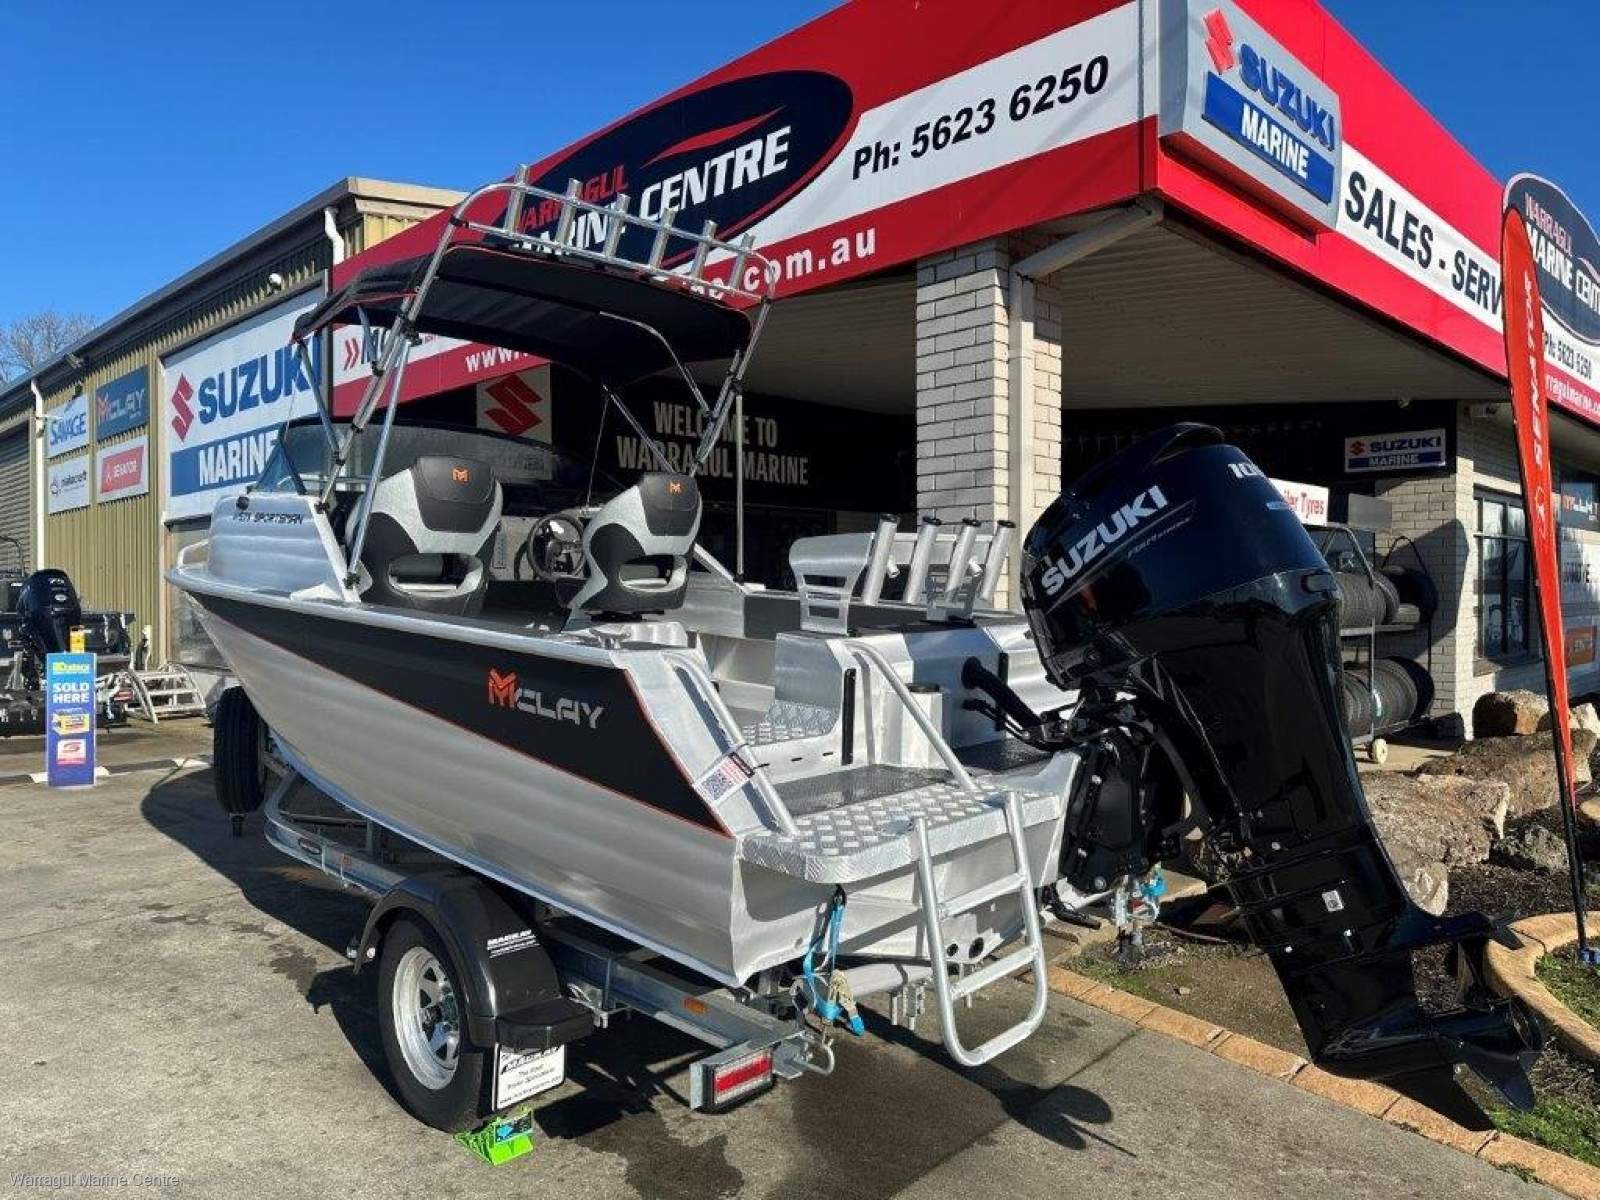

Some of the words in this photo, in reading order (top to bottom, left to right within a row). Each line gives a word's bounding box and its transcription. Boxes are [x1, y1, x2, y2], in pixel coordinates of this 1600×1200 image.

[852, 141, 901, 180] Ph:
[910, 98, 996, 158] 5623
[1008, 55, 1109, 121] 6250
[1239, 43, 1334, 152] SUZUKI
[1241, 103, 1309, 179] MARINE
[640, 126, 791, 222] CENTRE
[1345, 171, 1434, 270] SALES
[1452, 249, 1502, 315] SERV
[198, 336, 321, 425] SUZUKI
[755, 417, 778, 448] TO
[1369, 435, 1441, 452] SUZUKI
[743, 451, 809, 485] MARINE
[1368, 454, 1418, 468] MARINE
[1301, 492, 1325, 519] Tyres
[1041, 485, 1168, 595] SUZUKI
[53, 682, 90, 693] SOLD
[53, 693, 90, 704] HERE
